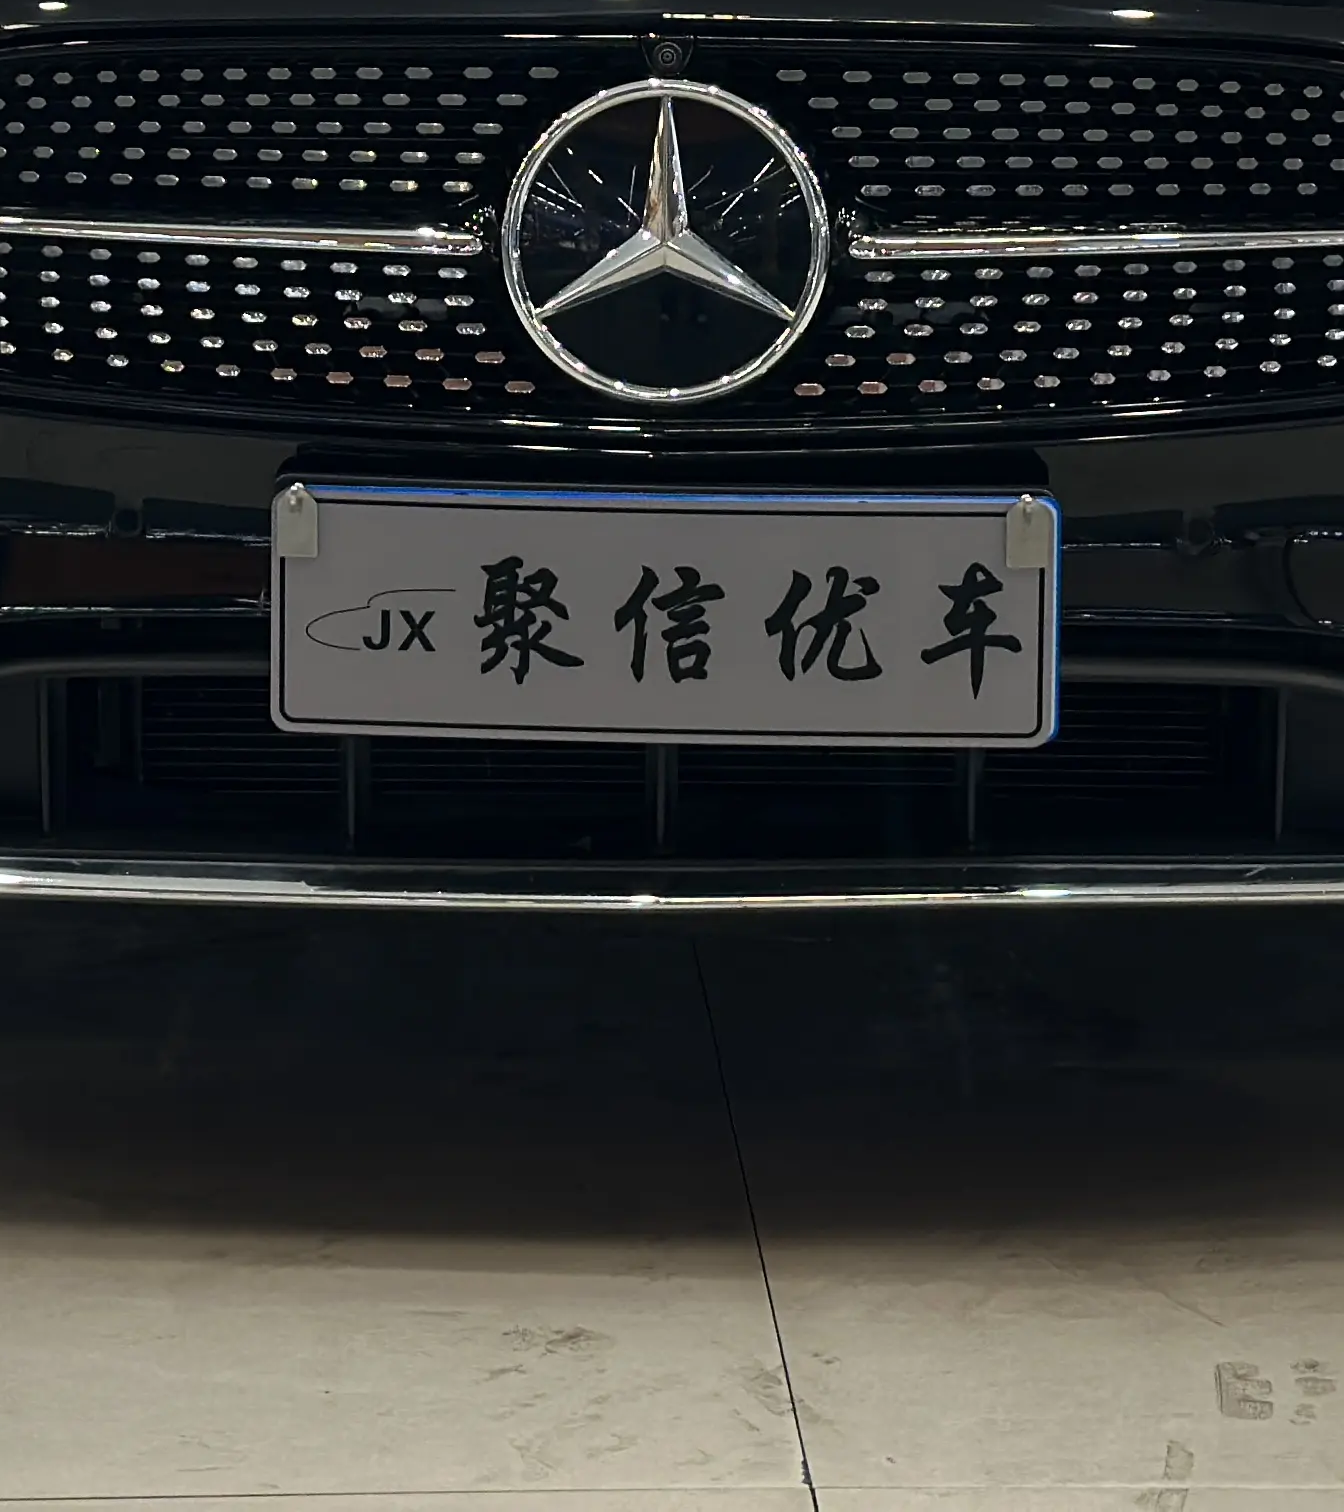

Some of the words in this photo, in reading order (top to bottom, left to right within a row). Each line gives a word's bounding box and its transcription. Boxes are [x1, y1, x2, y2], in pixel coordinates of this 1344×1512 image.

[362, 609, 437, 652] JX
[473, 555, 1024, 700] 聚信优车
